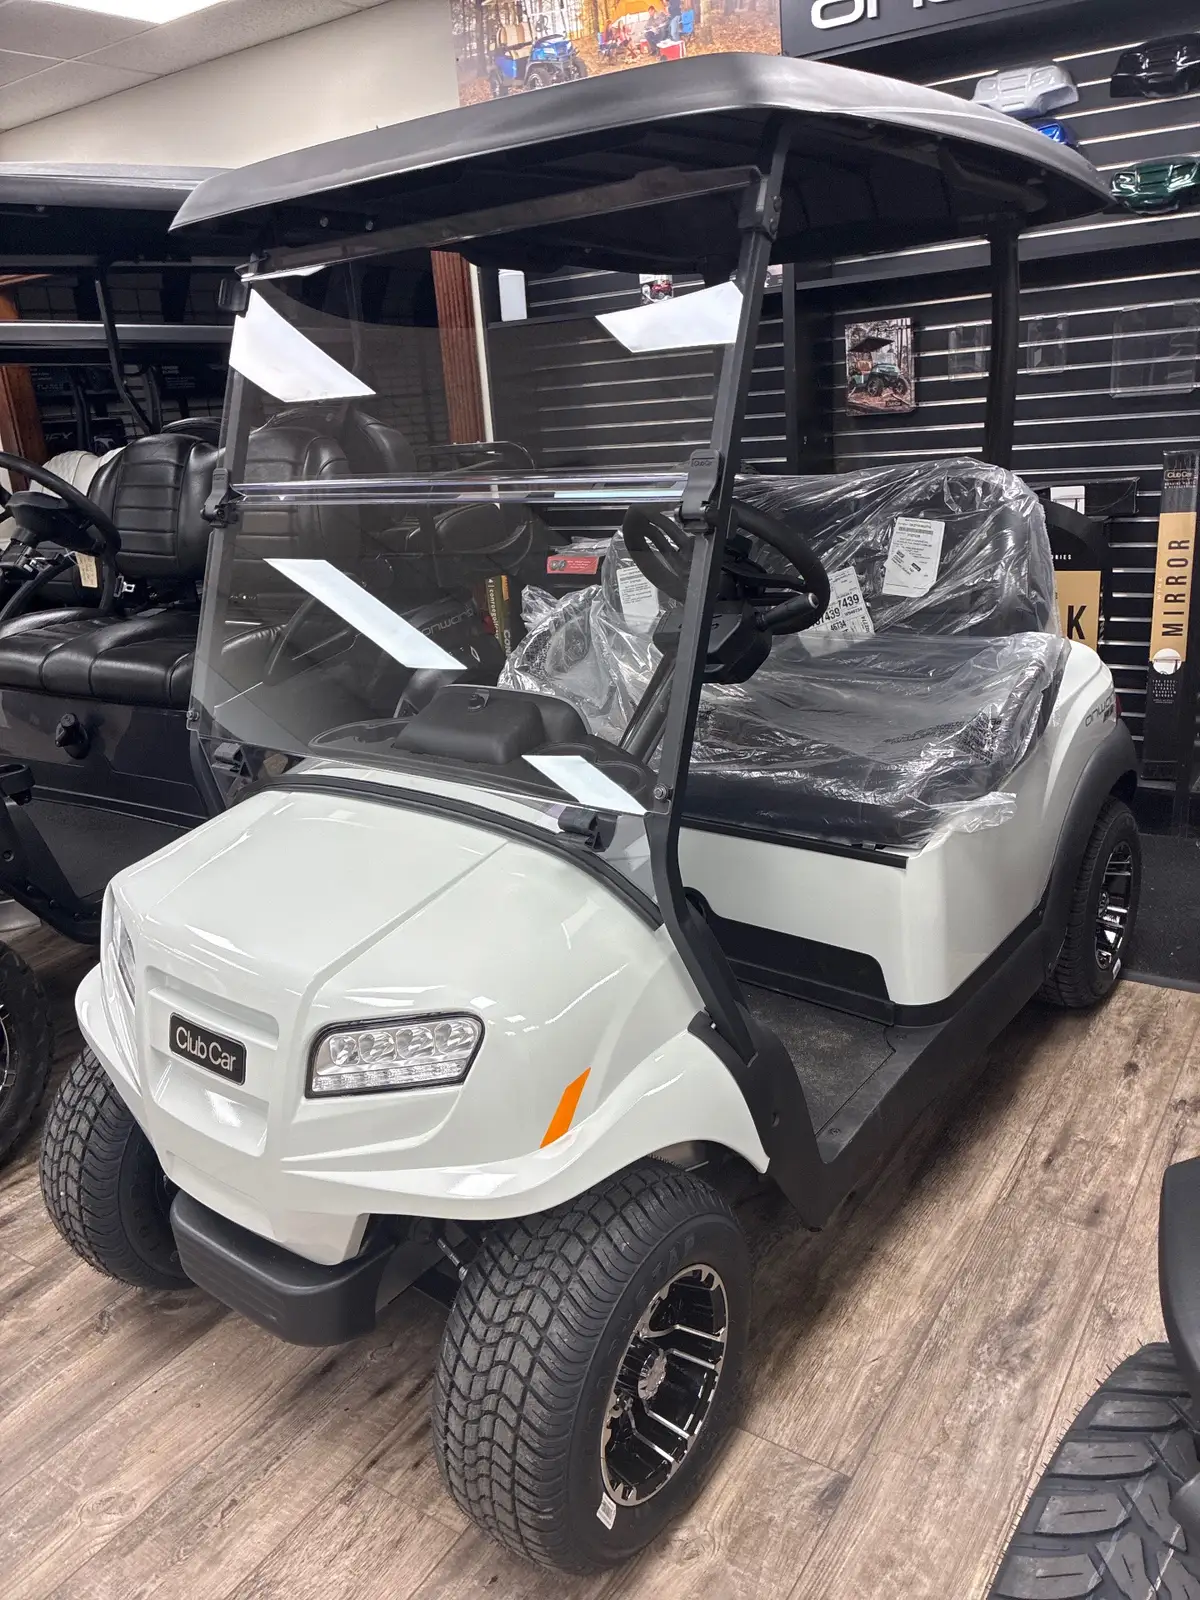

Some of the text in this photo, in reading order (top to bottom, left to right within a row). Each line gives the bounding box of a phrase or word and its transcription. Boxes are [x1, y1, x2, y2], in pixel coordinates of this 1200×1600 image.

[1162, 540, 1190, 637] MIRROR
[176, 1026, 236, 1072] Club Car
